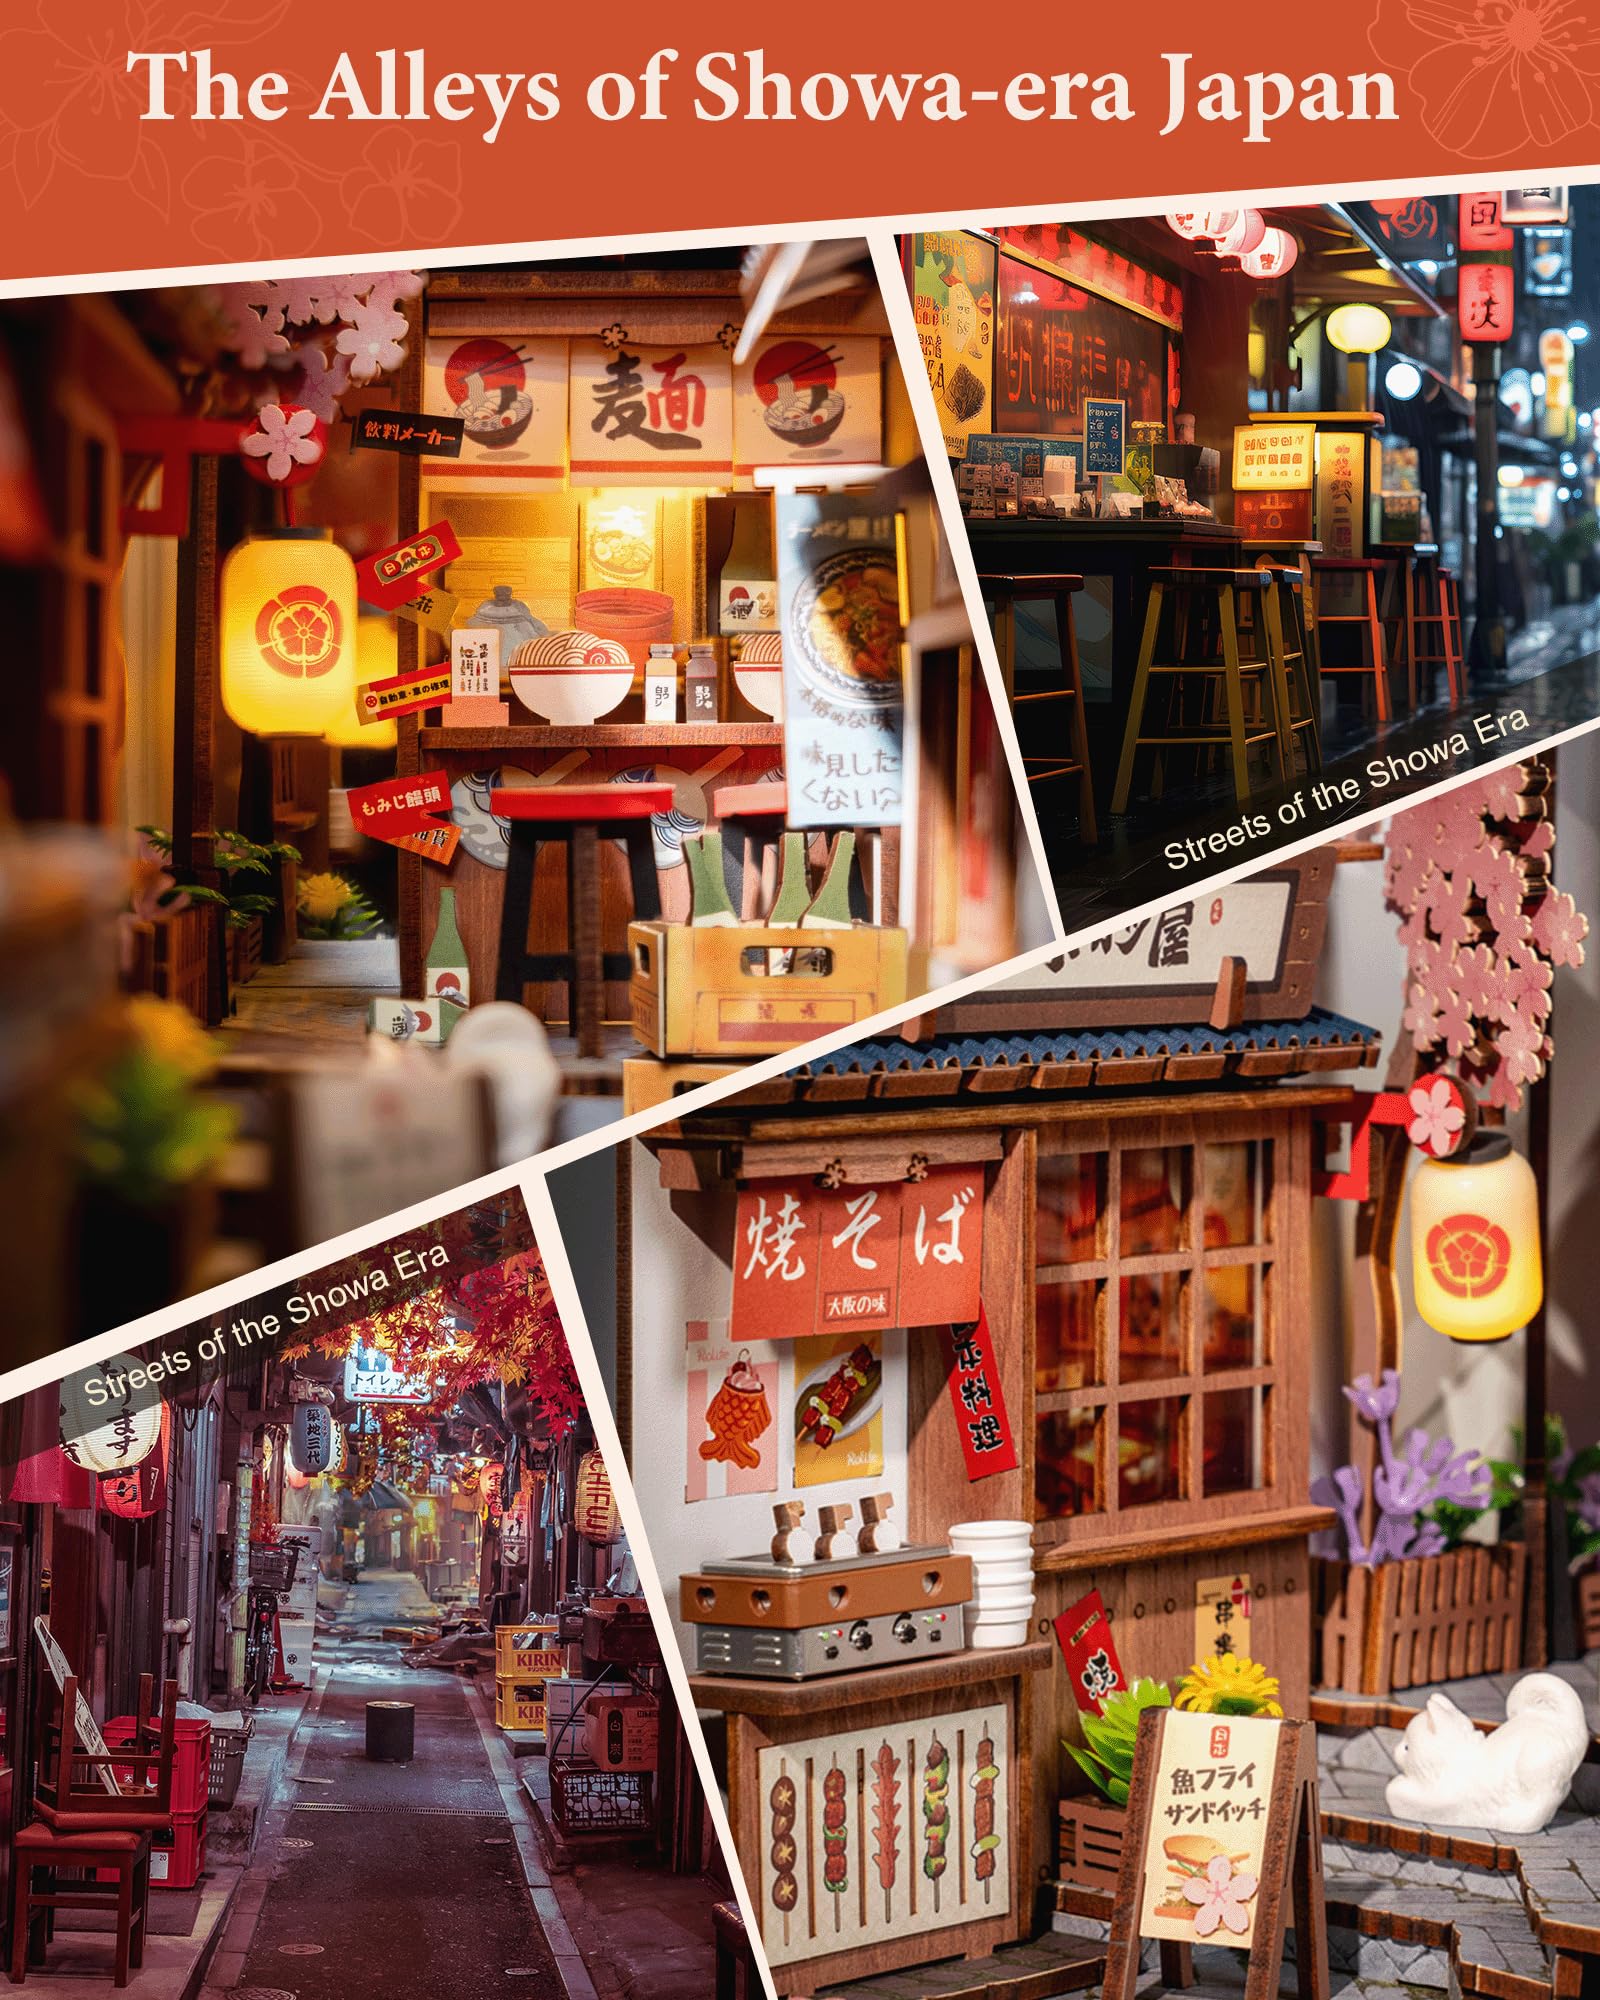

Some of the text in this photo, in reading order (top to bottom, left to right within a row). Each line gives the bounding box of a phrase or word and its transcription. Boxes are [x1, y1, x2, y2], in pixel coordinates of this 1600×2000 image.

[364, 419, 456, 446] 飲料メーカー
[362, 786, 441, 816] もみじ饅頭
[743, 1187, 974, 1281] 焼そば
[828, 1294, 887, 1316] 大阪の味
[355, 1374, 391, 1386] トイレ
[306, 1409, 320, 1464] 築地三代
[516, 1653, 562, 1667] KIRIN
[1170, 1762, 1256, 1795] 魚フライ
[1164, 1797, 1266, 1826] サンドイッチ
